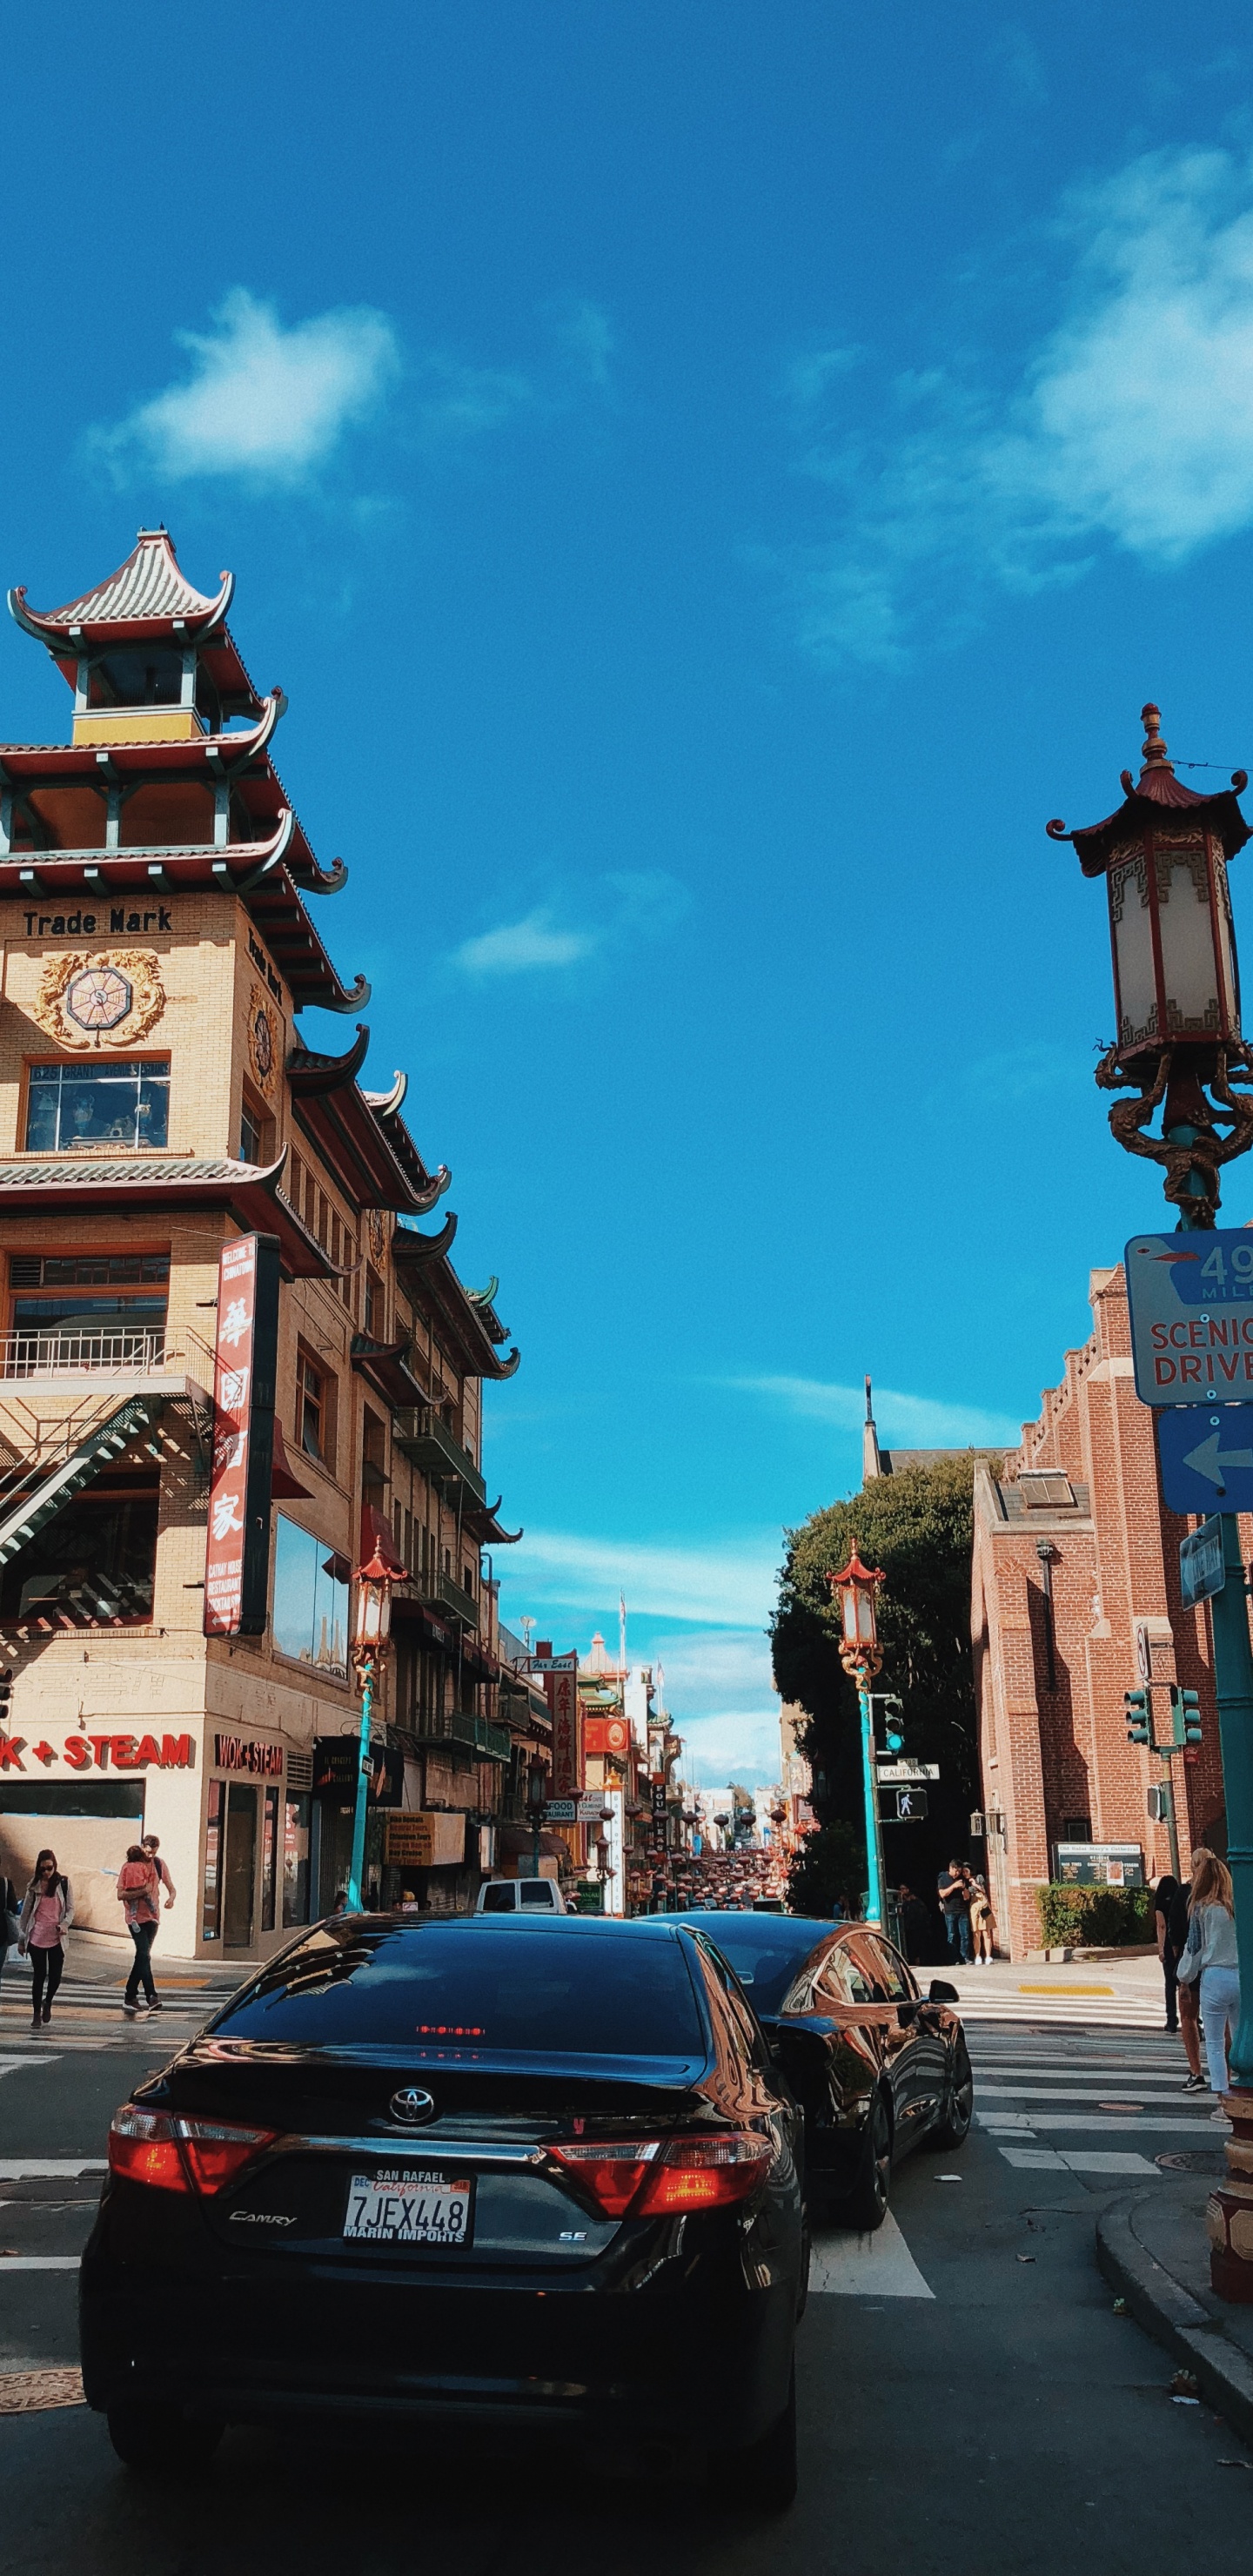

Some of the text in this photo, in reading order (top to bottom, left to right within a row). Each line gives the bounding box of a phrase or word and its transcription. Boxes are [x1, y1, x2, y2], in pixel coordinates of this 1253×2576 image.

[23, 906, 172, 936] Trade Mark
[34, 1066, 58, 1080] 625
[64, 1065, 95, 1077] GRANT
[223, 1245, 247, 1265] WELCOME
[1201, 1244, 1253, 1285] 49
[224, 1259, 255, 1281] CHINATOWN
[209, 1562, 226, 1578] CATHAY
[208, 1576, 241, 1595] RESTAURANT
[533, 1659, 572, 1669] Far East
[64, 1734, 191, 1766] STEAM
[219, 1734, 243, 1769] WOK
[252, 1741, 283, 1775] STEAM
[883, 1768, 934, 1778] CALIFORNIA
[376, 2170, 446, 2183] SAN RAFAEL
[354, 2177, 371, 2187] DEC
[372, 2180, 444, 2197] California
[228, 2210, 298, 2226] CAMRY
[352, 2196, 465, 2231] 7JEX448
[343, 2224, 465, 2243] MARIN IMPORTS
[559, 2231, 587, 2241] SE
